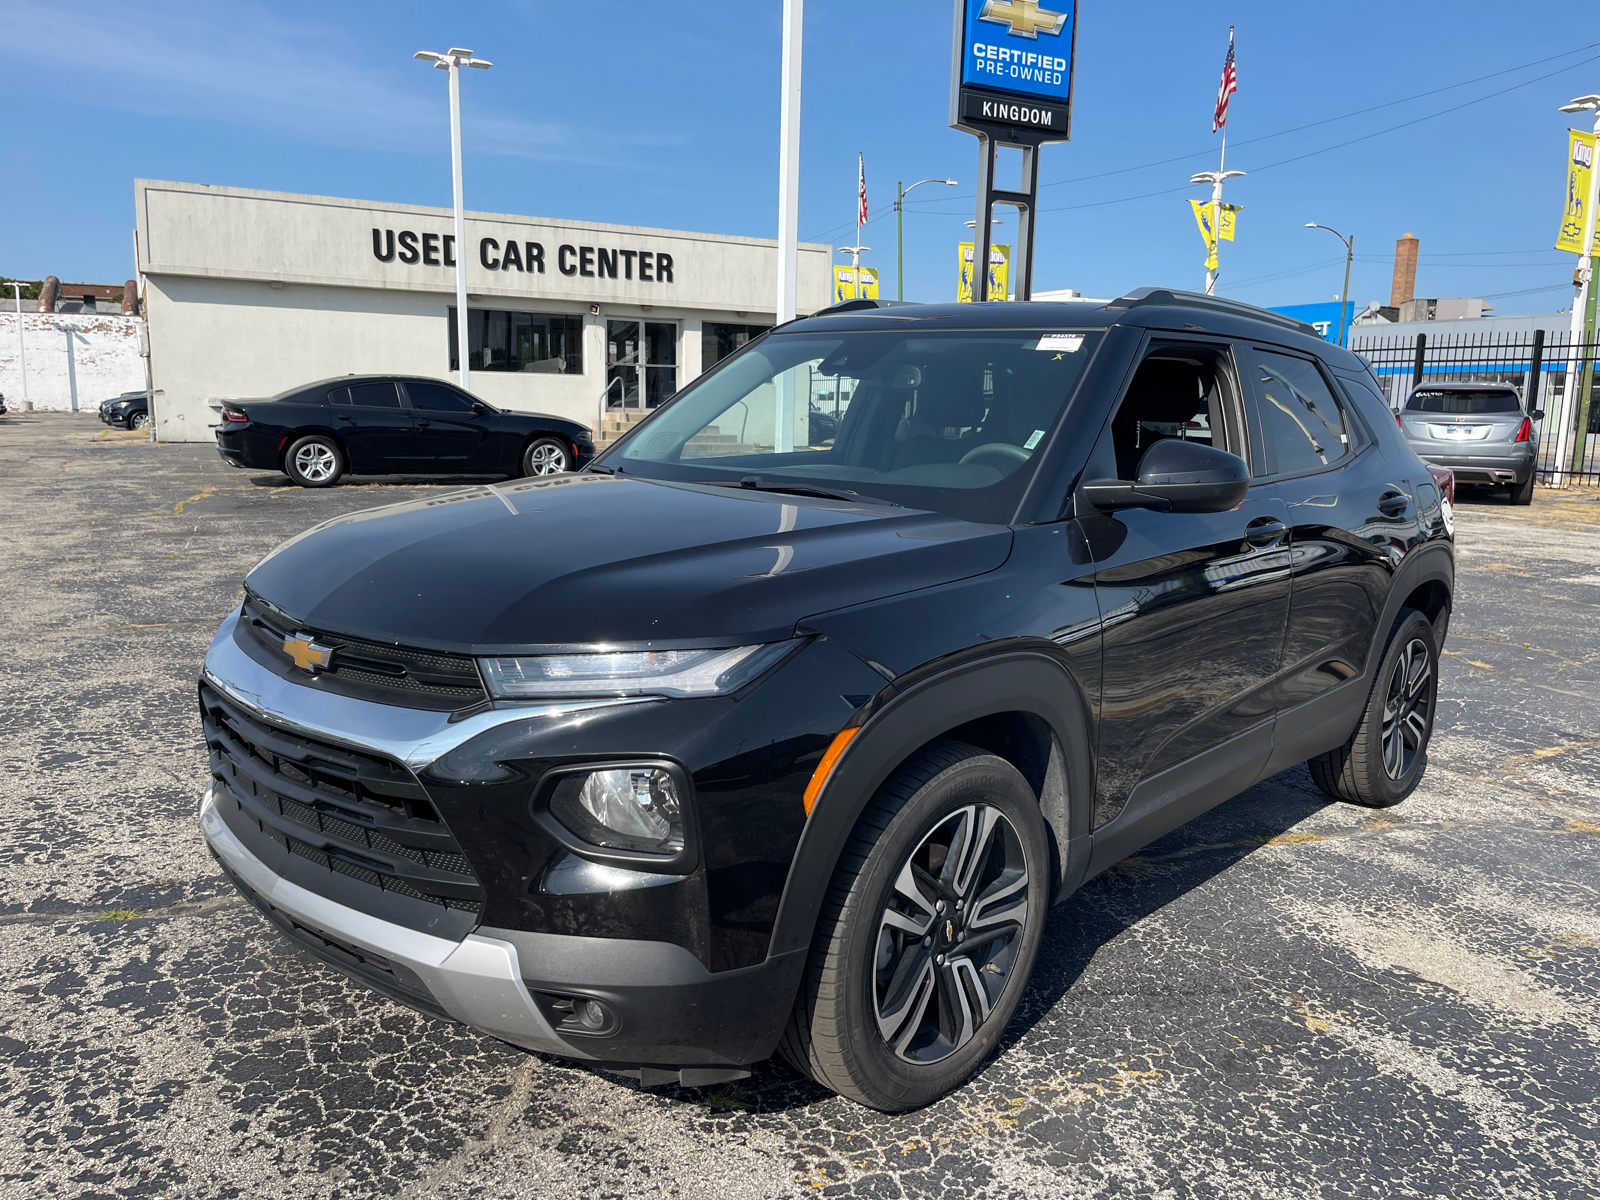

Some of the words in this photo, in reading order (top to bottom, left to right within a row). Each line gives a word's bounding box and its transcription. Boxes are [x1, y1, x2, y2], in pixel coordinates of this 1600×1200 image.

[973, 42, 1066, 72] CERTIFIED
[976, 59, 1062, 85] PRE-OWNED
[982, 101, 1052, 126] KINGDOM
[1573, 139, 1593, 168] King
[372, 228, 457, 266] USED
[479, 237, 546, 273] CAR
[558, 244, 674, 283] CENTER
[838, 269, 853, 283] King
